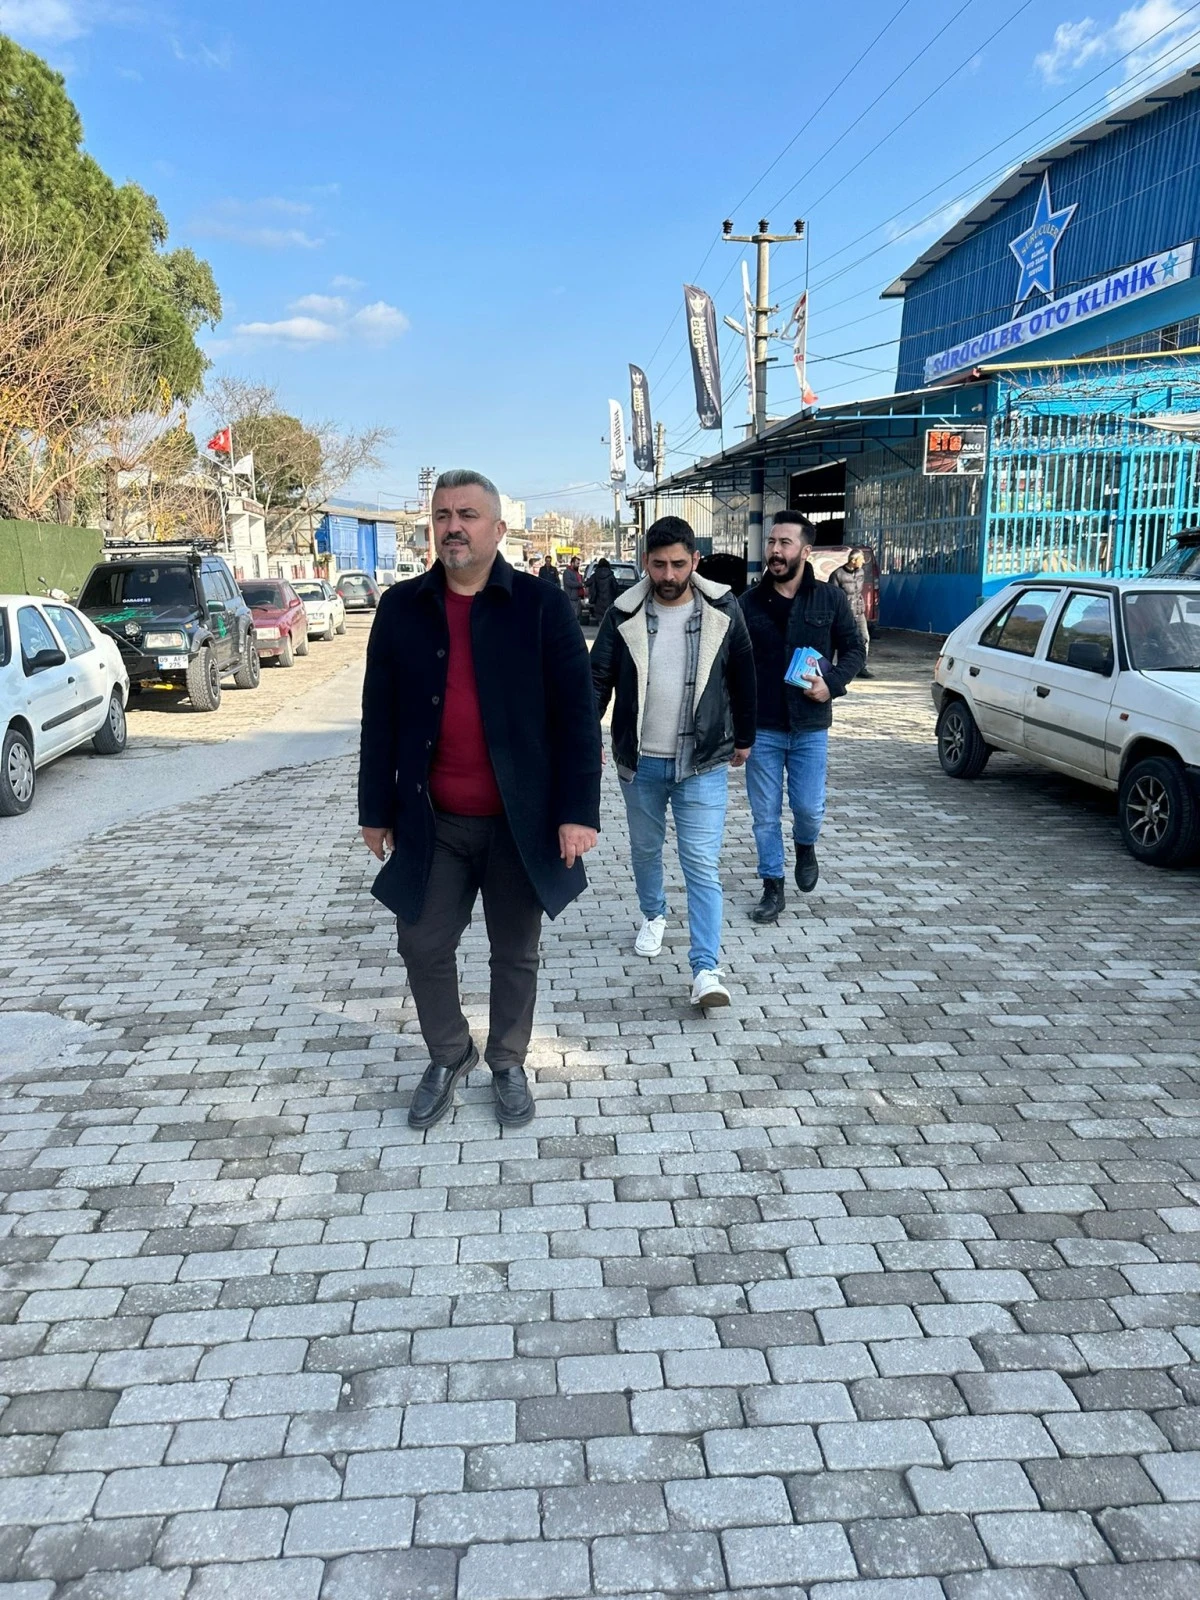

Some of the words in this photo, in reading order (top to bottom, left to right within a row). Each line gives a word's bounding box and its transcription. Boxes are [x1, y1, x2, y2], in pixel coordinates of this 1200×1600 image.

[932, 321, 1023, 374] SÜRÜCÜLER
[1029, 301, 1071, 335] OTO
[1076, 260, 1157, 316] KLİNİK
